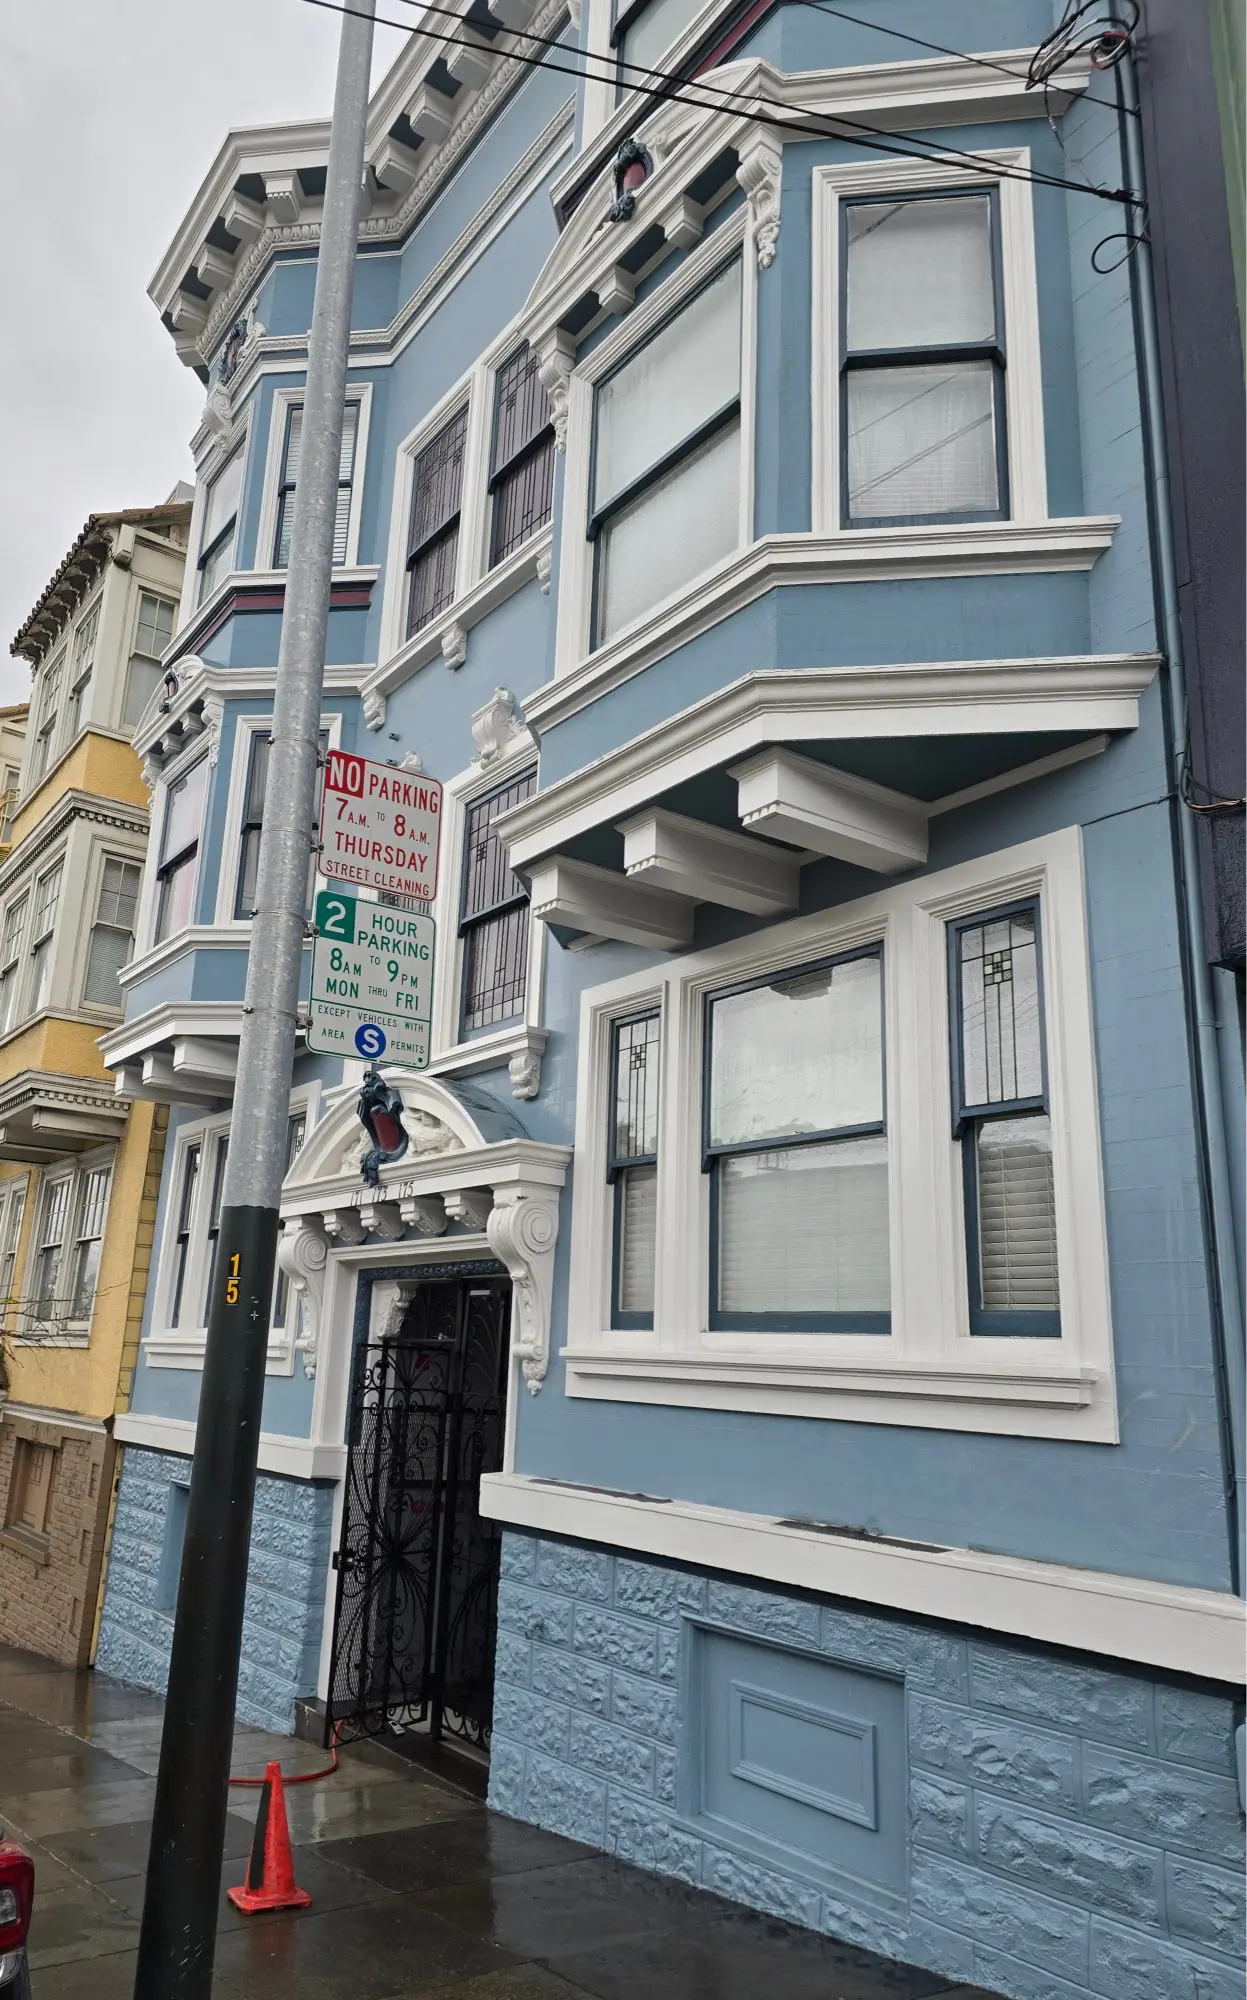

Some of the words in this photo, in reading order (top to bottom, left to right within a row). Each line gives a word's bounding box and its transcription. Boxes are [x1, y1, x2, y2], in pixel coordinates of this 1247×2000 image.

[329, 756, 361, 793] NO
[369, 773, 438, 814] PARKING
[377, 811, 386, 822] TO
[335, 831, 428, 873] THURSDAY
[326, 860, 370, 881] STREET
[374, 872, 430, 896] CLEANING
[324, 901, 346, 934] 2
[372, 914, 417, 938] HOUR
[357, 931, 429, 960] PARKING
[370, 955, 380, 966] TO
[326, 978, 359, 998] MON
[368, 986, 388, 998] THRU
[396, 991, 419, 1011] FRI
[318, 1005, 350, 1019] EXCEPT
[358, 1012, 397, 1028] VEHICLES
[404, 1021, 424, 1033] WITH
[321, 1028, 345, 1040] AREA
[361, 1028, 379, 1054] S
[390, 1040, 425, 1054] PERMITS
